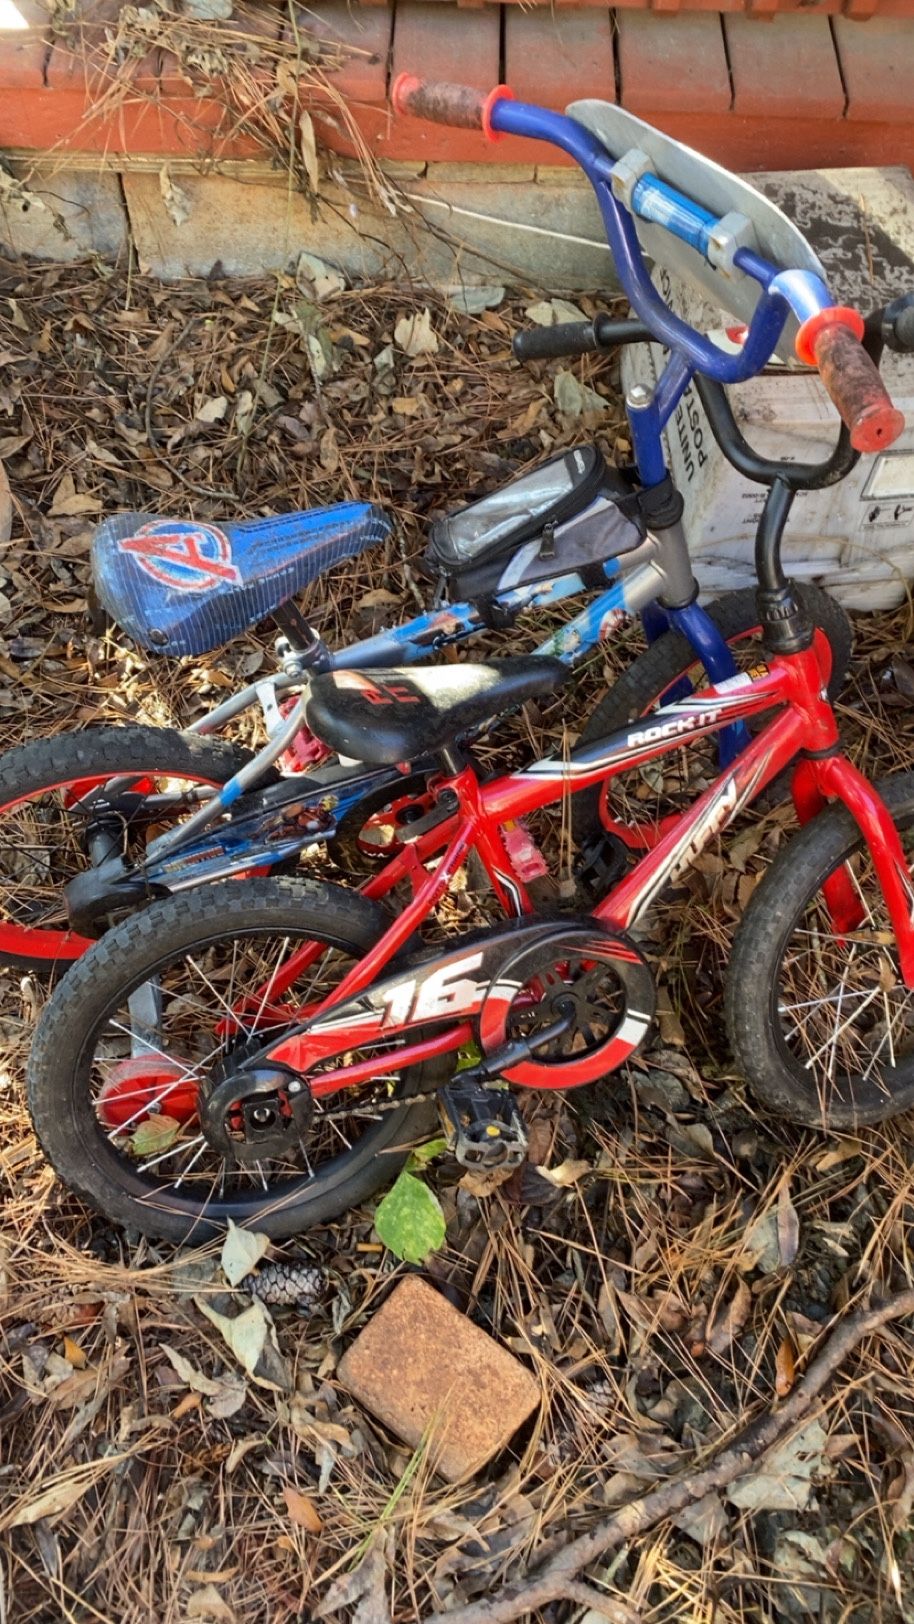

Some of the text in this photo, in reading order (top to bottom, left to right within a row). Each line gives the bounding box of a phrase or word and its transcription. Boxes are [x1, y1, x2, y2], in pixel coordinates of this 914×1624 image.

[675, 404, 695, 482] UNITE
[683, 385, 708, 468] POST
[627, 715, 696, 748] ROCK
[382, 951, 484, 1028] 16
